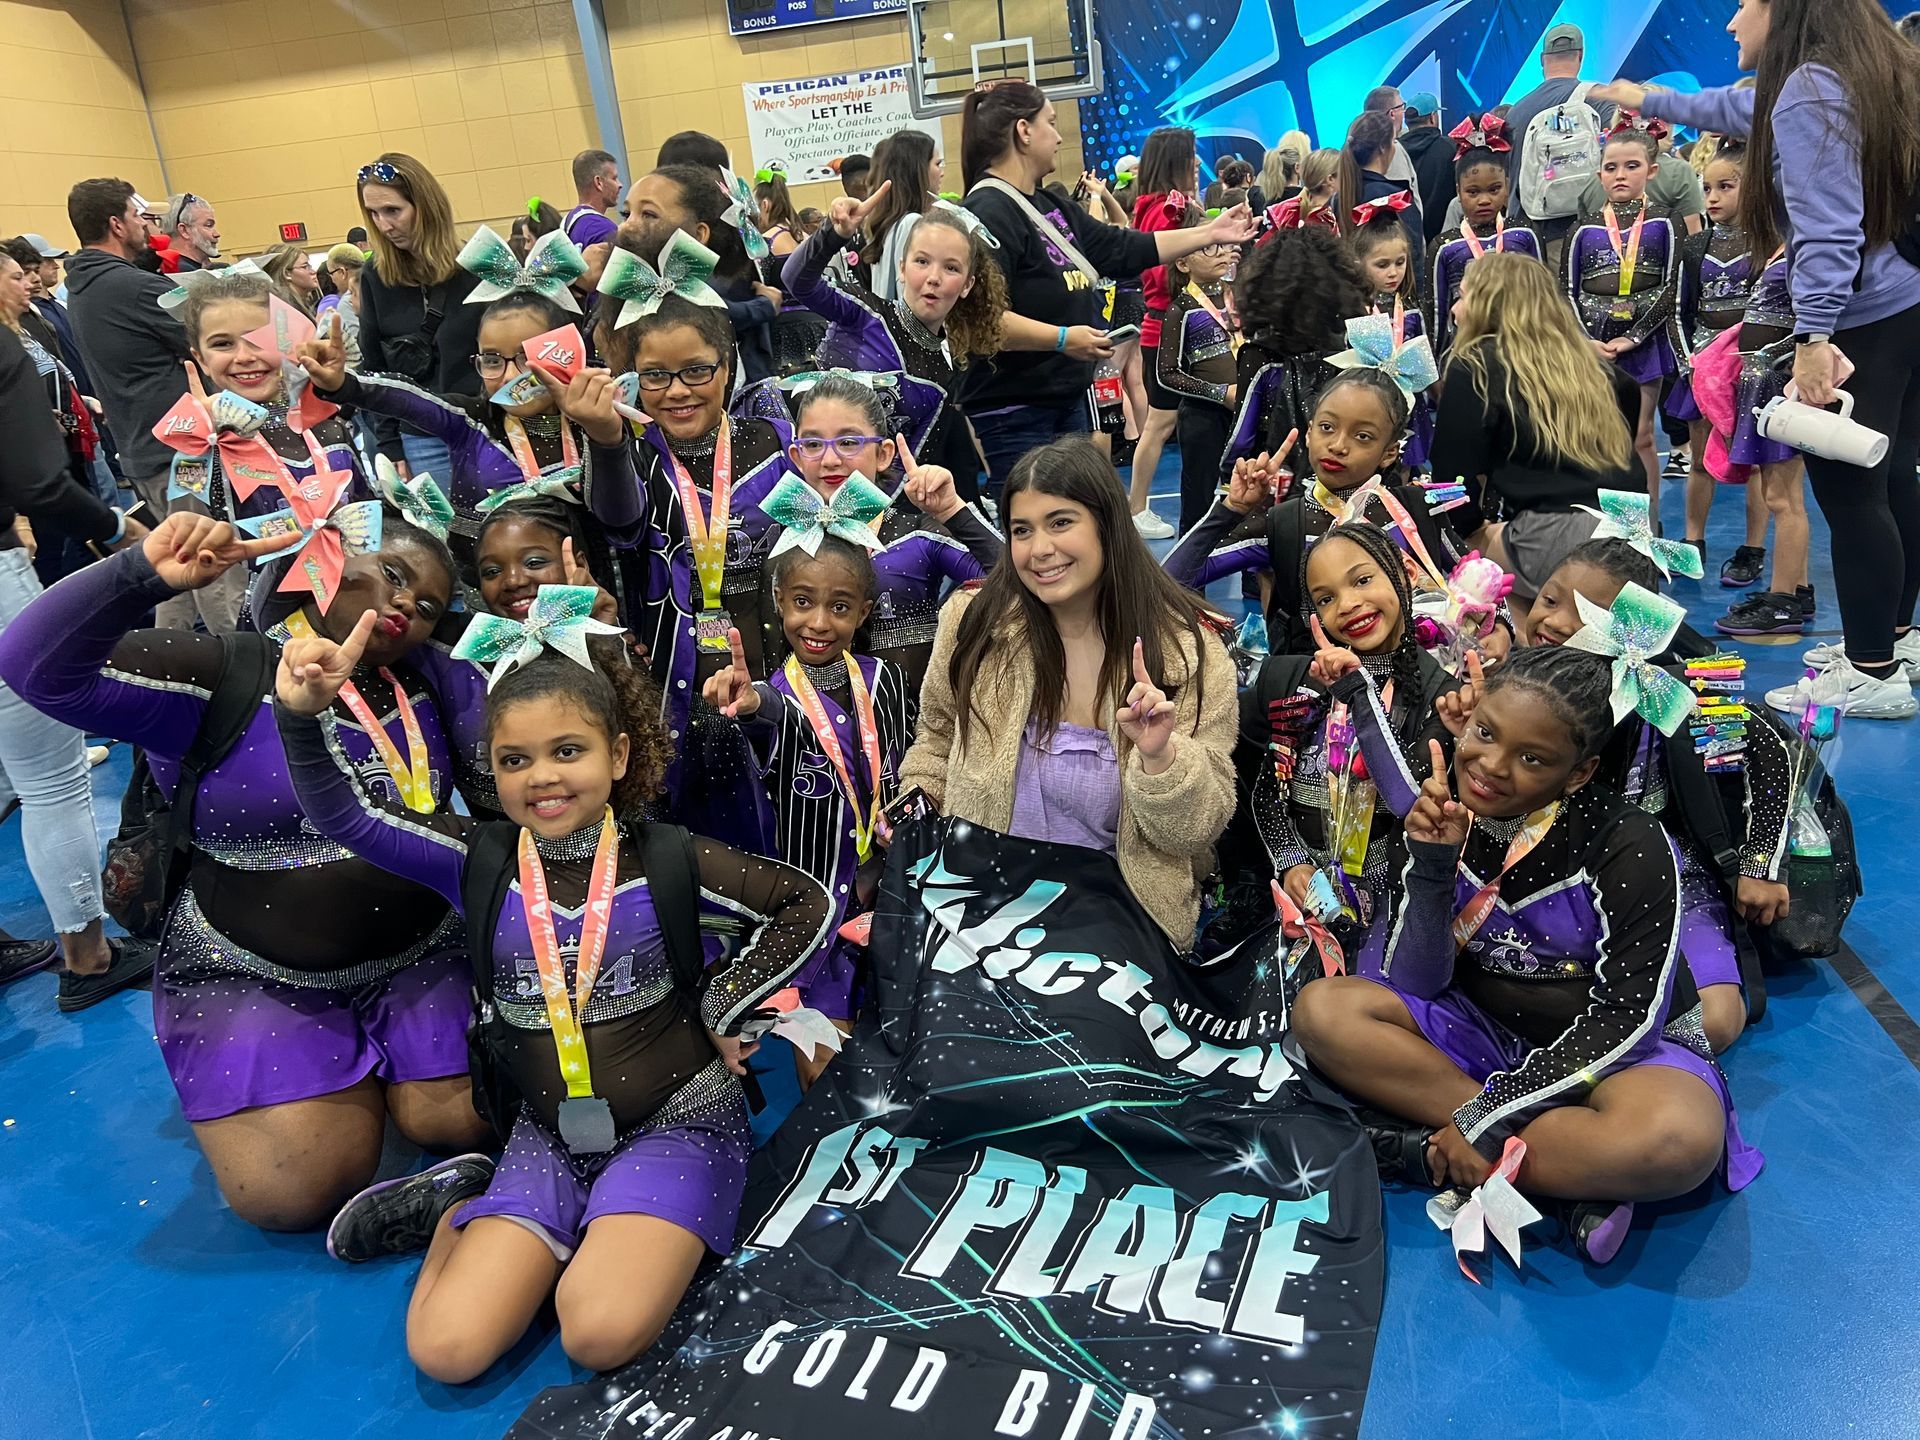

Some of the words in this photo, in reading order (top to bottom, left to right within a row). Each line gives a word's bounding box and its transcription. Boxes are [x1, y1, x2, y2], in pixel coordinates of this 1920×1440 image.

[788, 2, 807, 11] POSS
[743, 15, 777, 29] BONUS
[753, 99, 785, 112] Where
[788, 88, 864, 108] Sportsmanship
[867, 85, 877, 97] Is
[880, 82, 887, 95] A
[759, 75, 848, 96] PELICAN
[811, 107, 838, 120] LET
[843, 101, 873, 116] THE
[764, 123, 804, 138] Players
[807, 119, 834, 133] Play,
[837, 114, 883, 129] Coaches
[886, 111, 914, 123] Coac
[784, 134, 830, 149] Officials
[833, 128, 884, 143] Officiate,
[886, 123, 908, 135] and
[787, 146, 844, 162] Spectators
[847, 143, 862, 154] Be
[283, 224, 300, 239] EXIT
[537, 340, 575, 365] 1st
[163, 415, 196, 437] 1st
[299, 480, 325, 501] 1st
[1453, 893, 1498, 941] Victory
[905, 845, 1302, 1103] Victory
[743, 1120, 929, 1252] 1ST
[897, 1144, 1332, 1348] PLACE
[740, 1319, 949, 1413] GOLD
[993, 1367, 1158, 1440] BID
